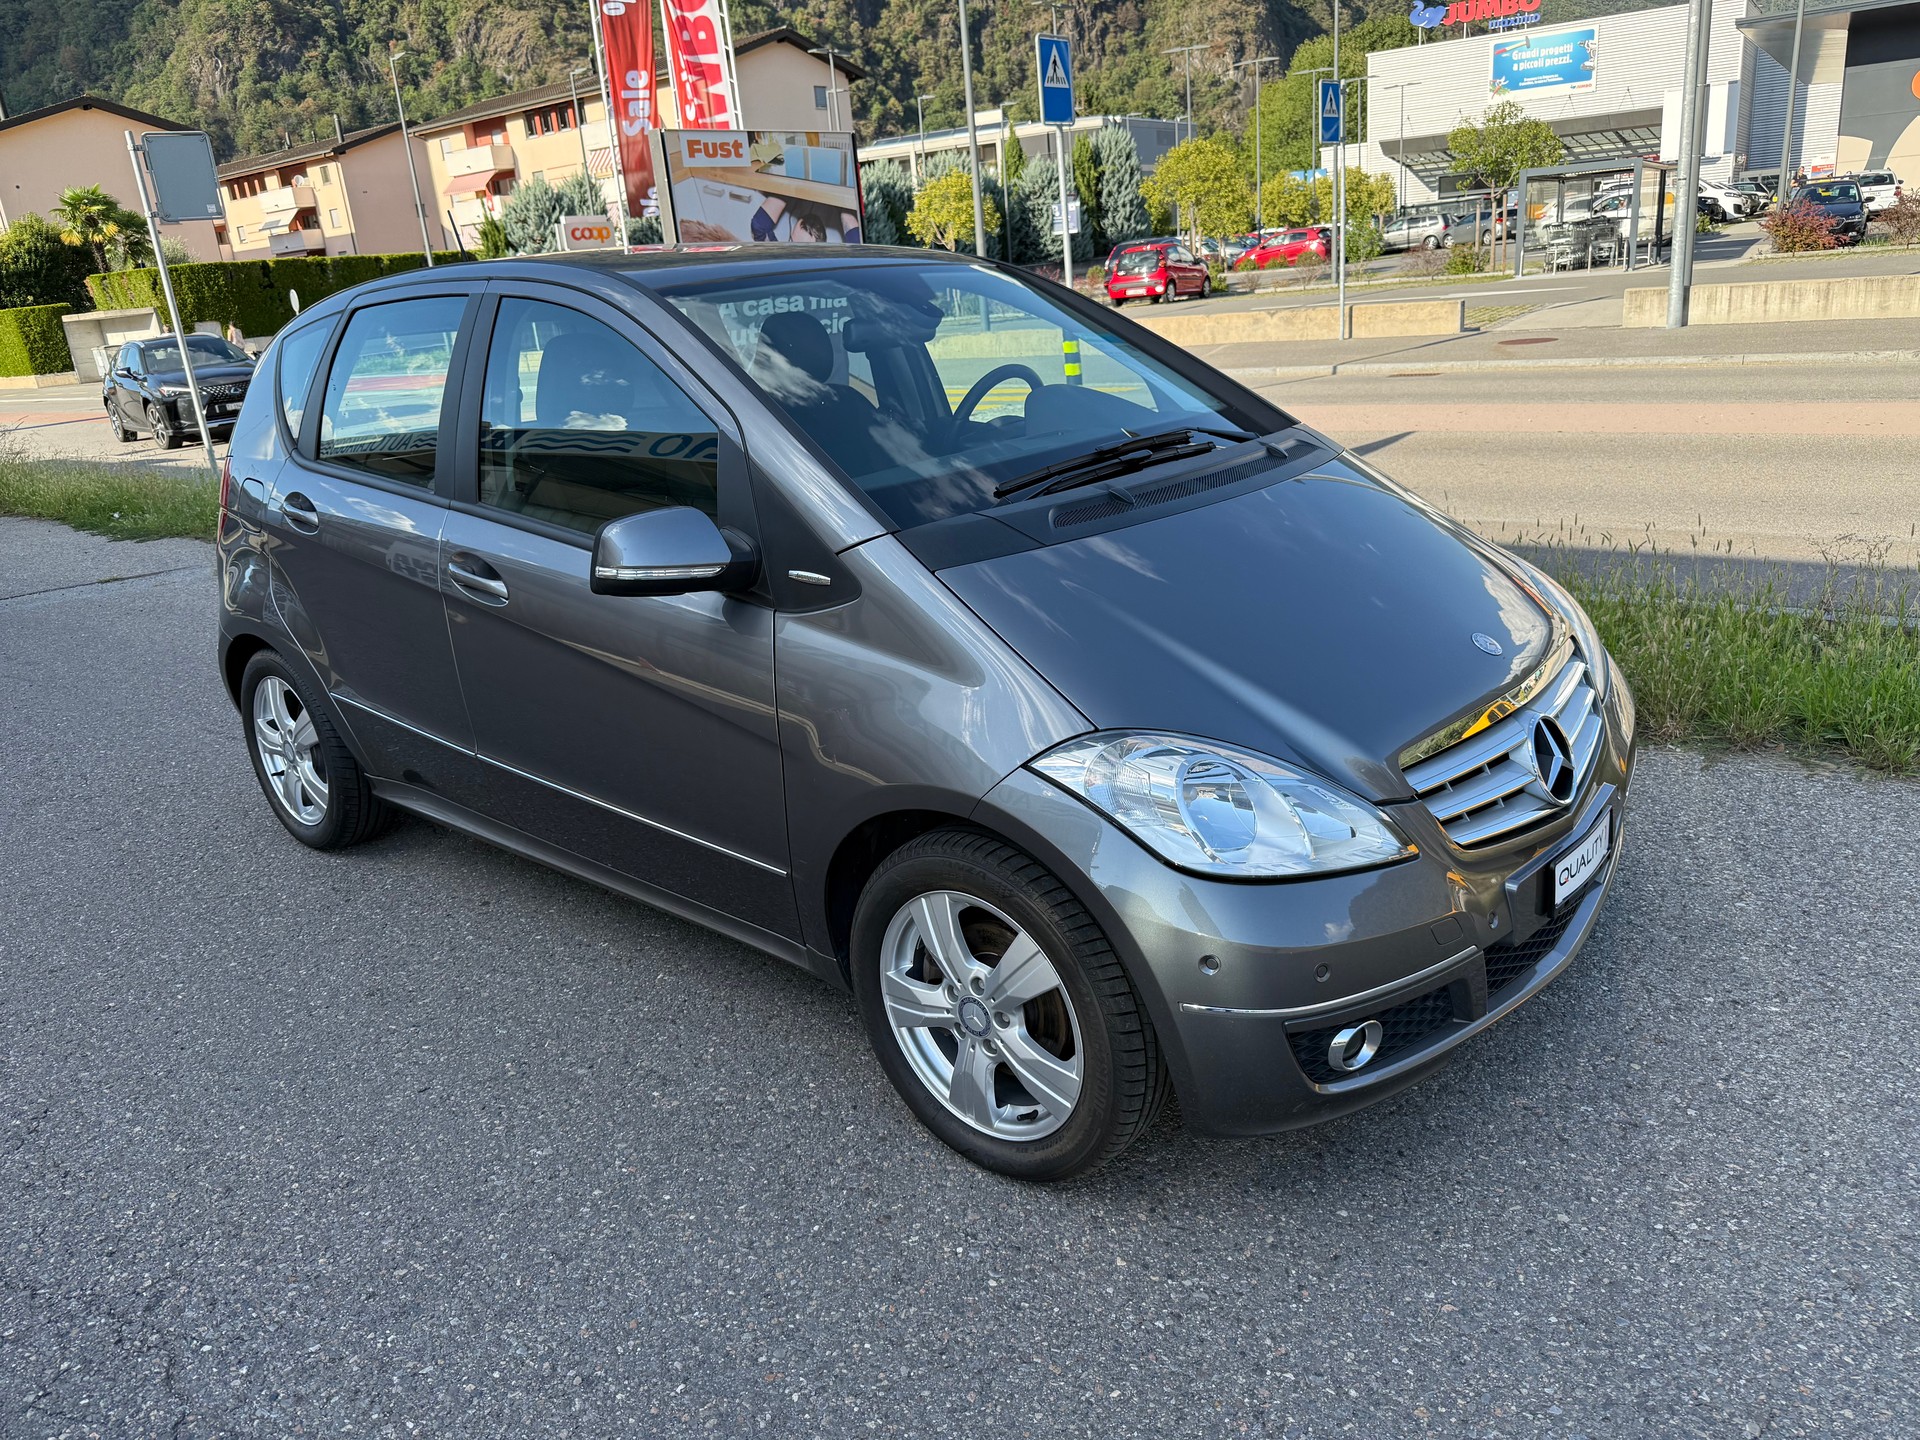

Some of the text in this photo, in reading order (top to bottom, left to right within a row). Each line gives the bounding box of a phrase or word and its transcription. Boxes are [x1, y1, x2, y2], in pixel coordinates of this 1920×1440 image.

[1443, 0, 1541, 26] JUMBO
[1512, 42, 1574, 60] Grandi progetti
[1512, 54, 1573, 71] a piccoli prezzi.
[621, 70, 652, 137] Sale
[687, 139, 744, 159] Fust
[571, 226, 611, 243] coop
[742, 295, 805, 318] casa
